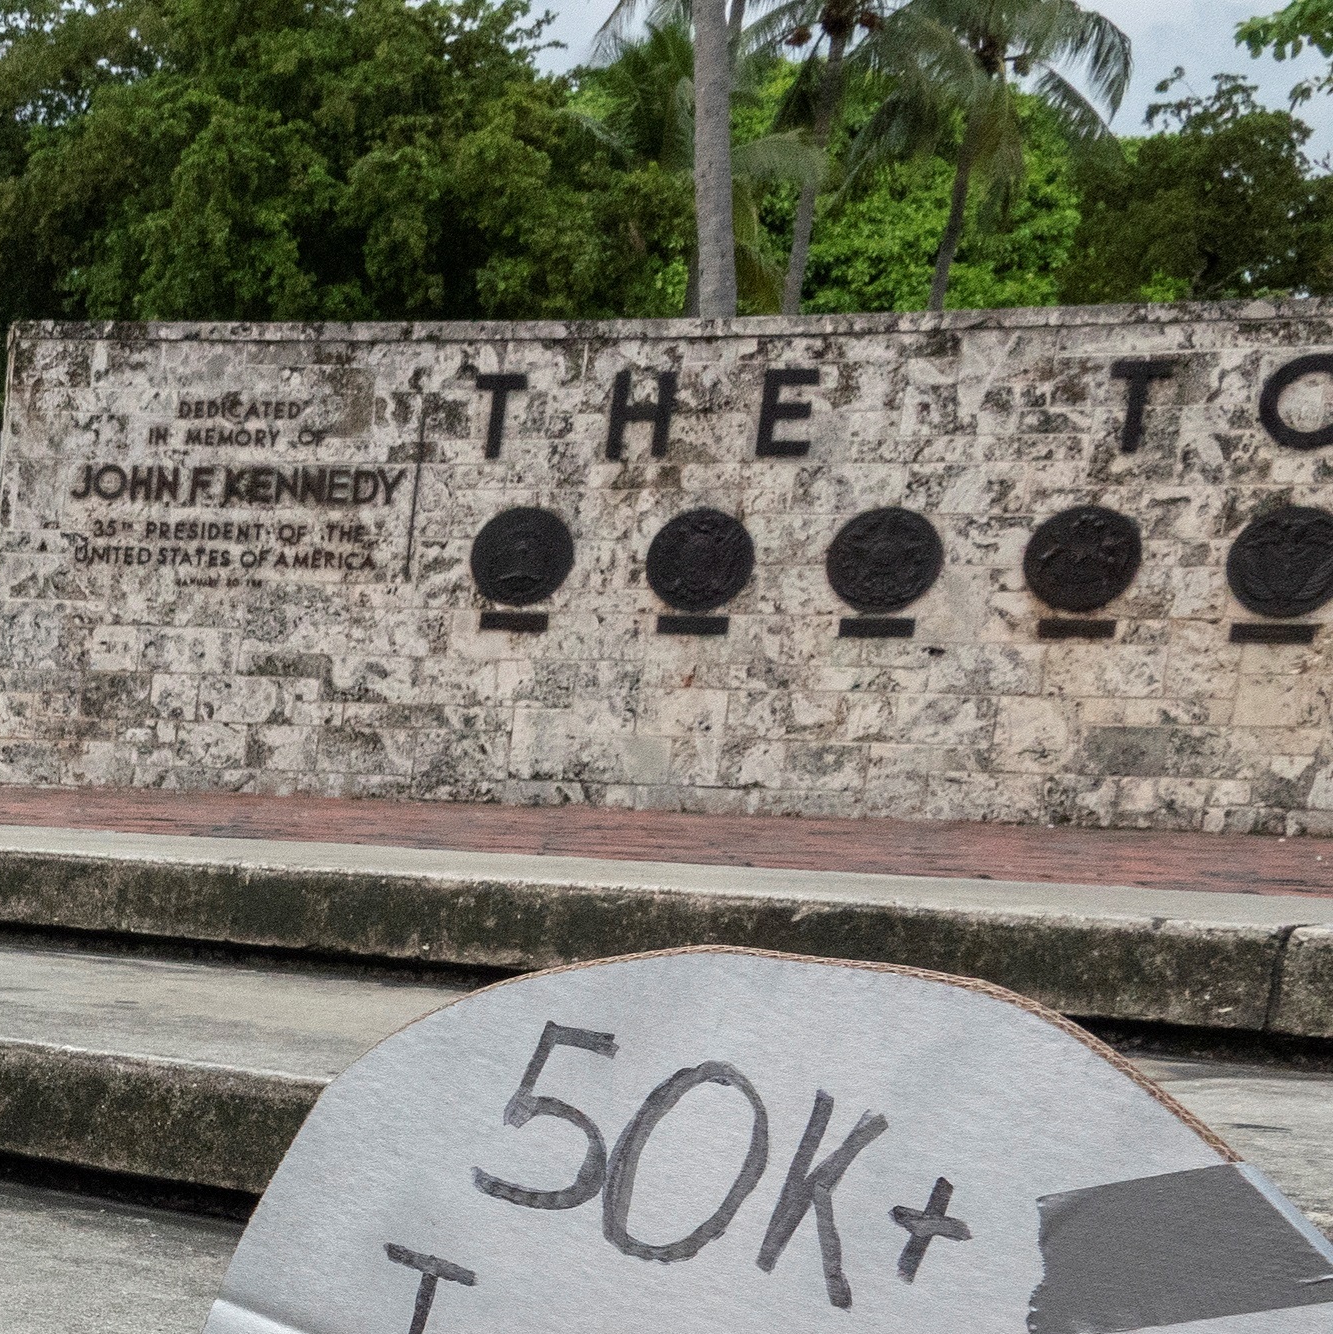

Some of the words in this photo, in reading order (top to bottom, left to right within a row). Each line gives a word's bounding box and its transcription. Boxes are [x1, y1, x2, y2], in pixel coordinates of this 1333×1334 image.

[178, 400, 301, 420] DEDICATED
[476, 368, 820, 461] THE
[148, 427, 169, 446] IN
[185, 428, 281, 447] MEMORY
[298, 428, 326, 447] OF
[71, 464, 180, 501] JOHN
[221, 466, 407, 505] KENNEDY
[145, 521, 264, 542] PRESIDENT
[278, 523, 309, 544] OF
[326, 524, 366, 544] THE
[74, 547, 152, 567] UNITED
[158, 548, 232, 568] STATES
[240, 550, 268, 569] OF
[275, 552, 377, 571] AMERICA
[472, 1021, 971, 1311] 50K+
